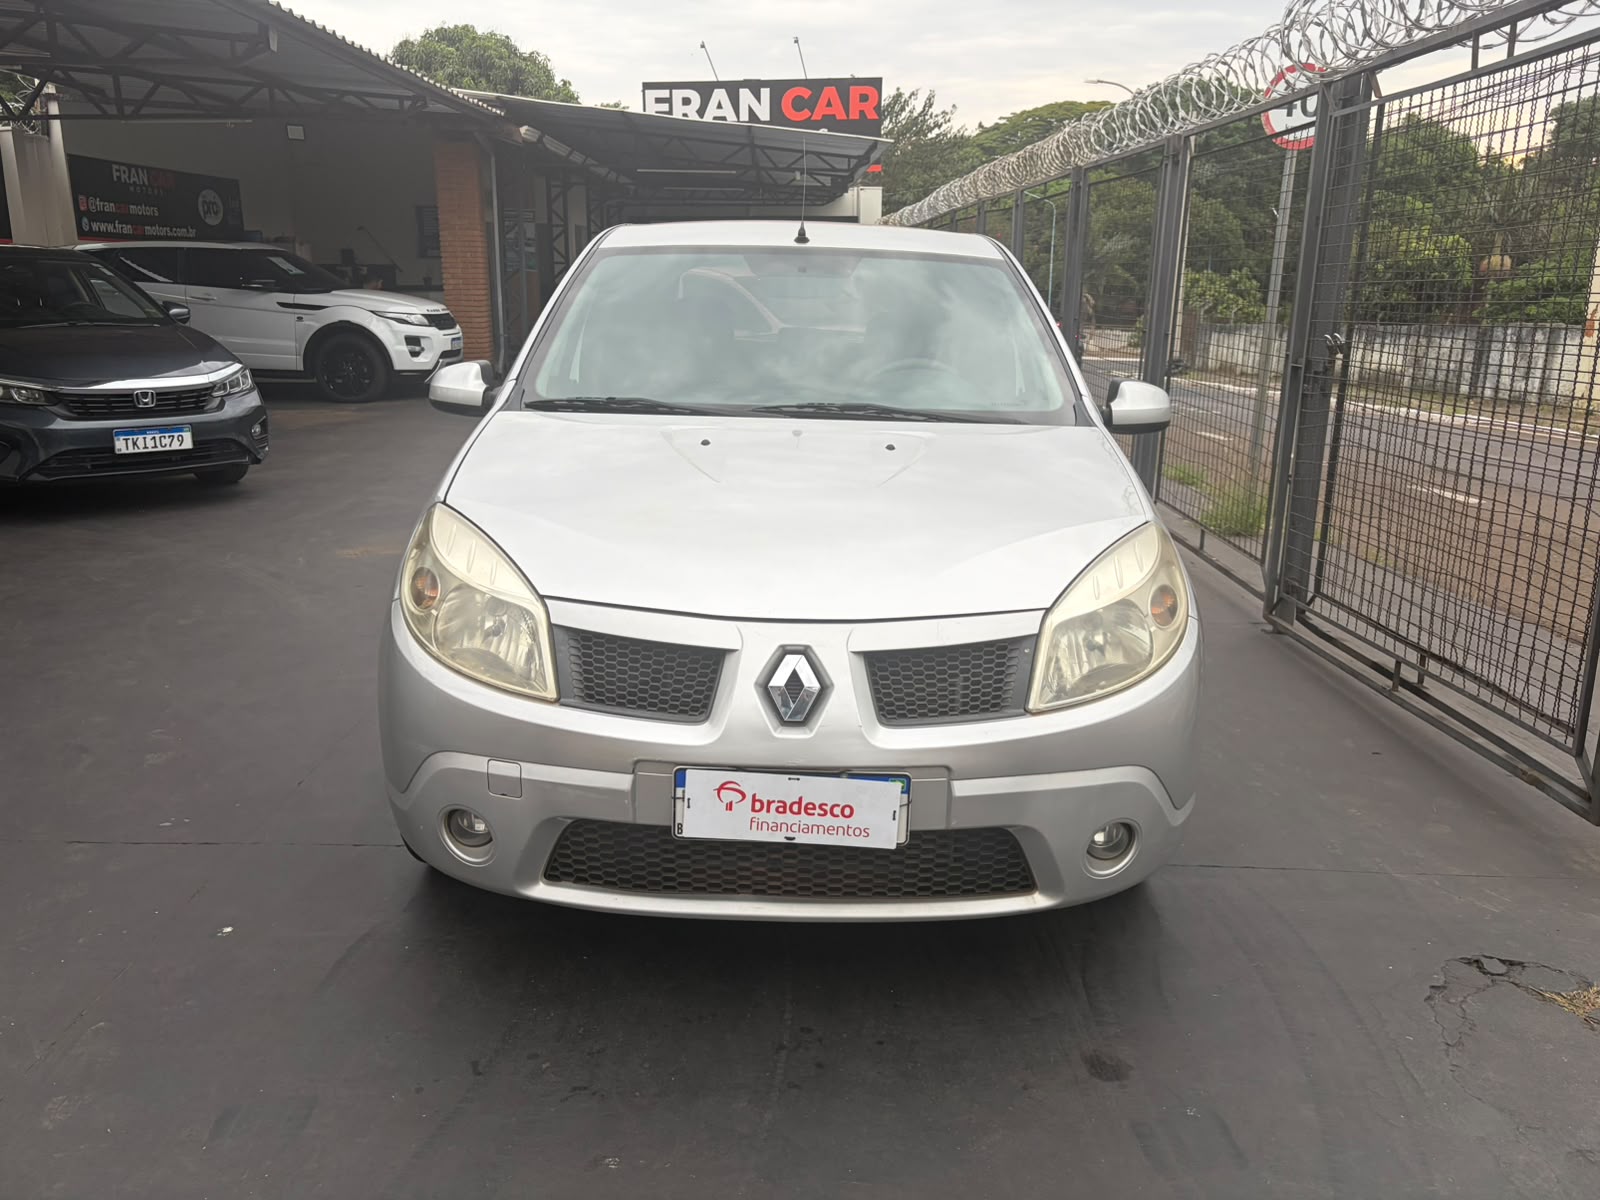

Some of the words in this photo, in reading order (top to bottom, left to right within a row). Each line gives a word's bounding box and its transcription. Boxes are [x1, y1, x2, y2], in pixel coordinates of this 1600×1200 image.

[644, 87, 770, 122] FRAN
[781, 86, 879, 121] CAR
[111, 163, 149, 186] FRAN
[122, 434, 184, 451] TKI1C79
[751, 793, 855, 819] bradesco
[749, 816, 870, 838] financiamentos
